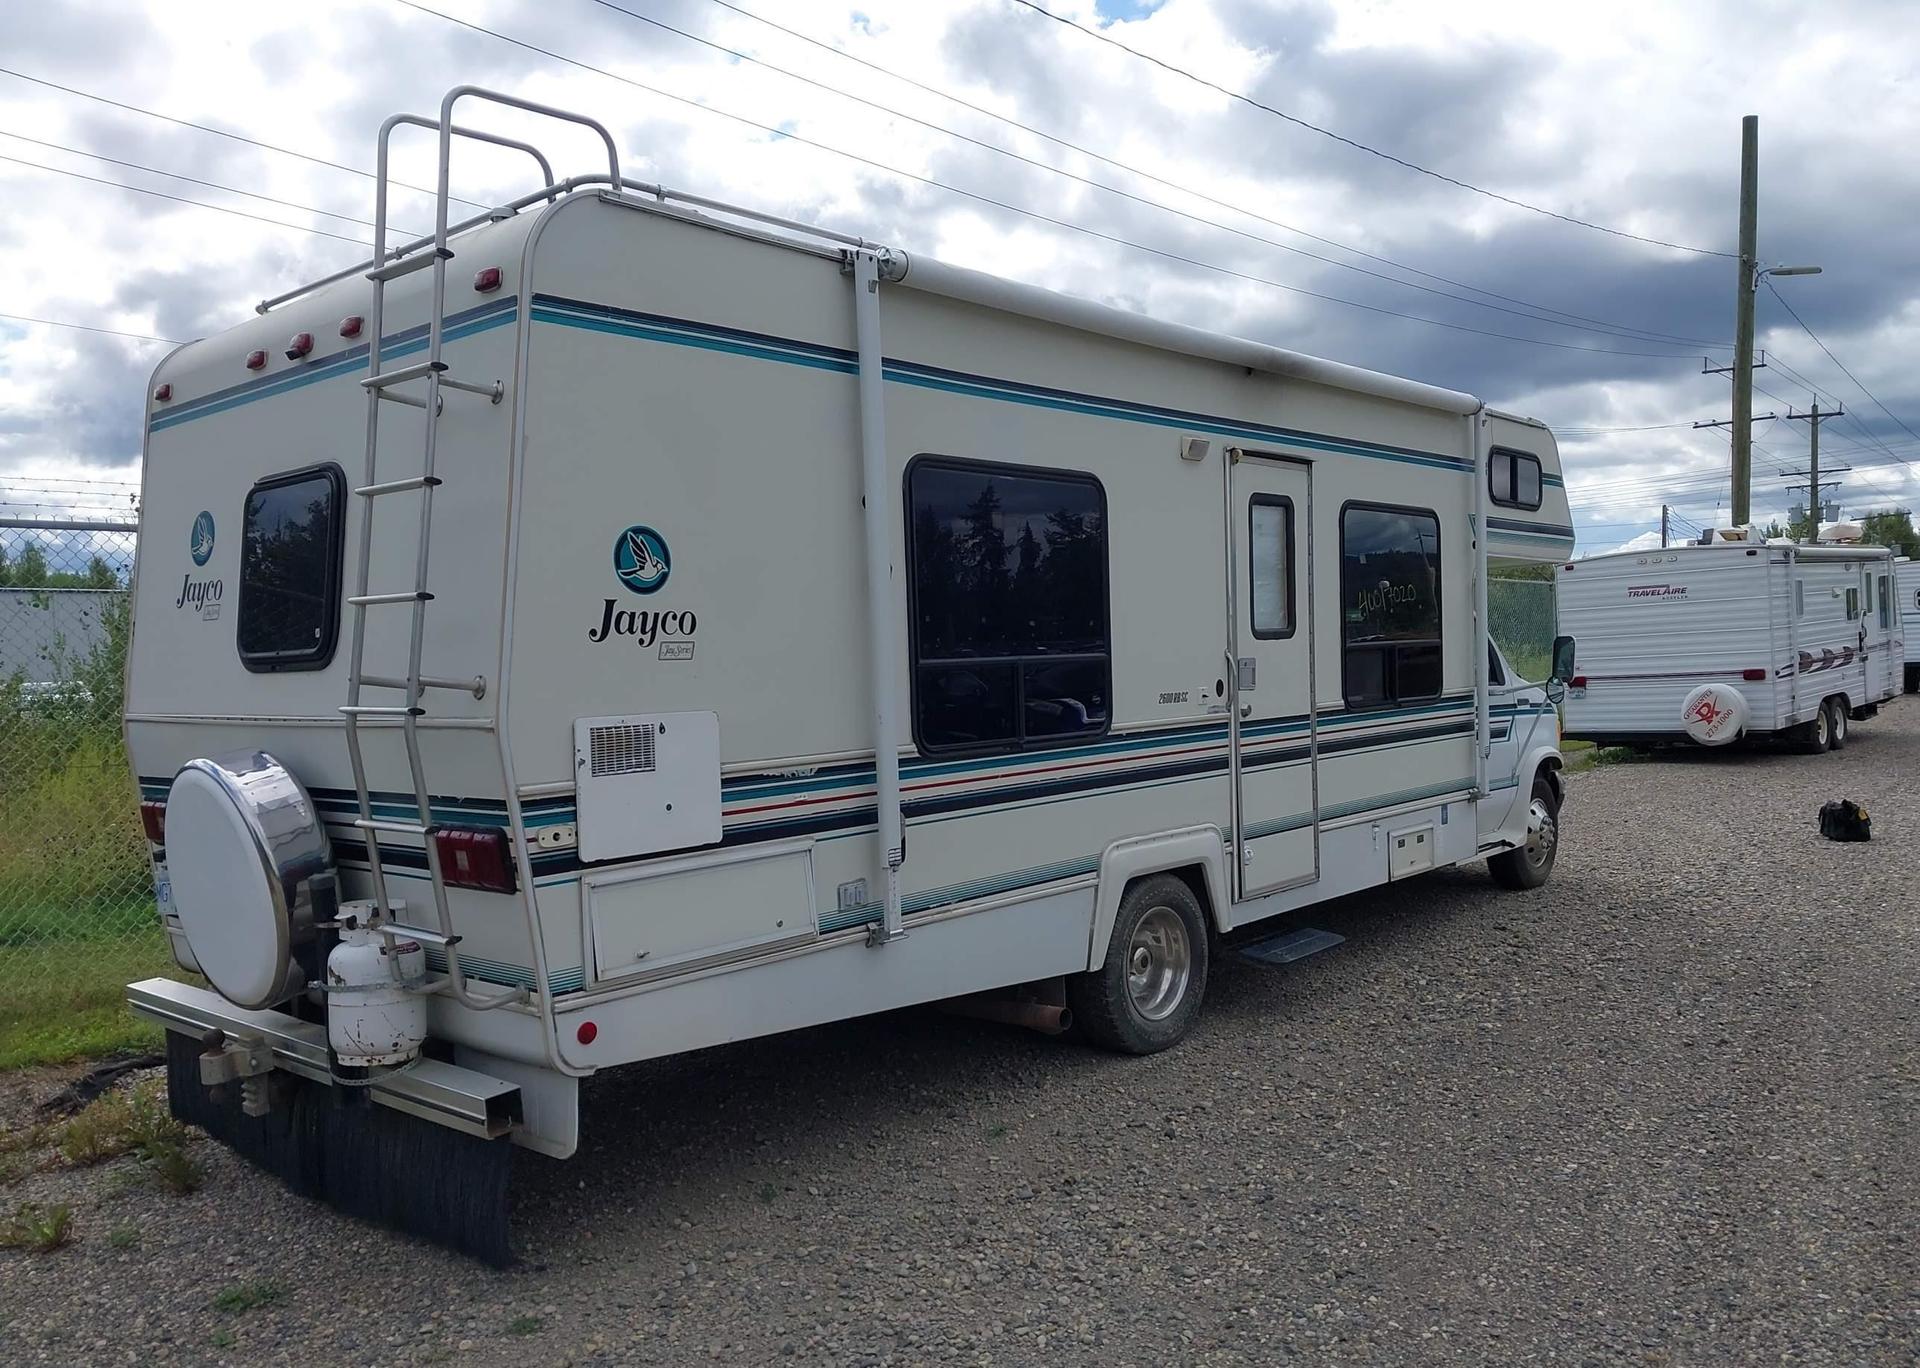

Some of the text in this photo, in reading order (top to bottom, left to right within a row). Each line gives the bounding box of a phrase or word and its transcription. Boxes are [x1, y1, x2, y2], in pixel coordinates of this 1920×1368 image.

[176, 573, 223, 612] Jayco
[1628, 586, 1688, 598] TRAVELAIRE
[589, 599, 697, 648] Jayco
[1706, 708, 1733, 738] 273-1000
